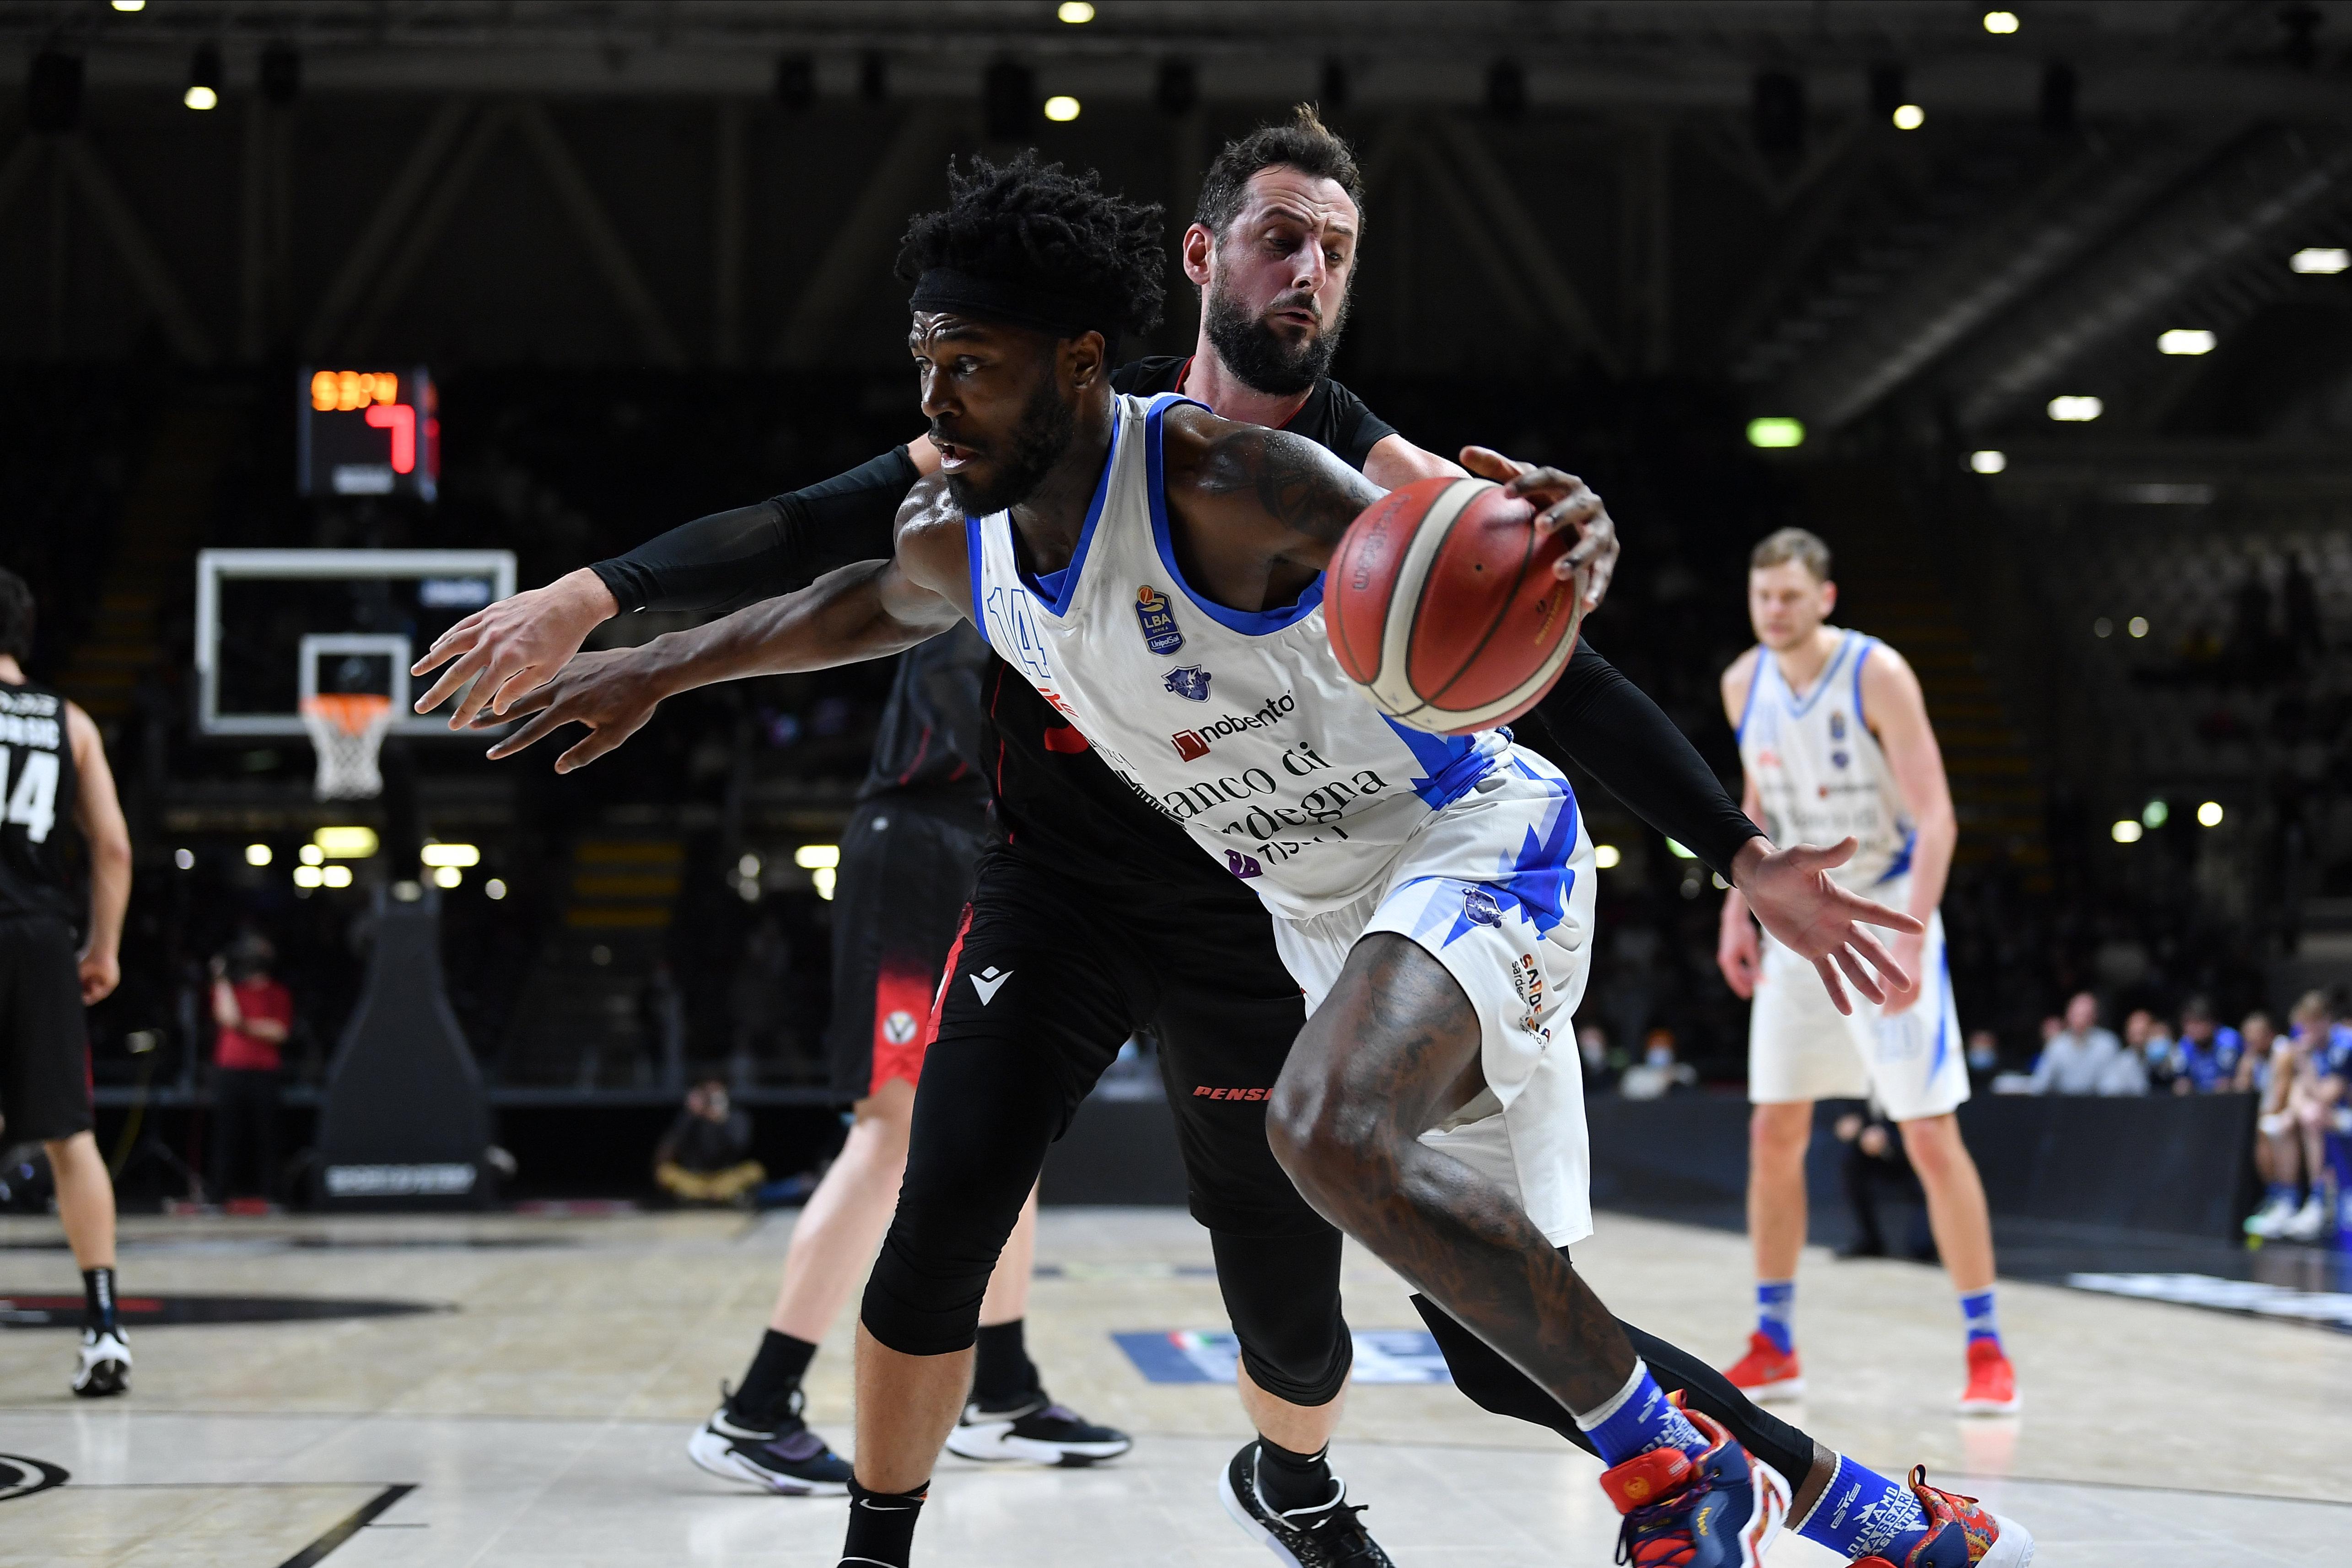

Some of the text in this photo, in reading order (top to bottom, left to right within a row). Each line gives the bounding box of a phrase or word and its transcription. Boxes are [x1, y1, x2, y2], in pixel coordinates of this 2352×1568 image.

[987, 586, 1052, 679] 14
[1144, 613, 1171, 629] LBA
[1198, 693, 1295, 744] nobento
[1163, 768, 1277, 819] anco
[1282, 741, 1335, 776] di
[1847, 1486, 1899, 1553] DINAMO
